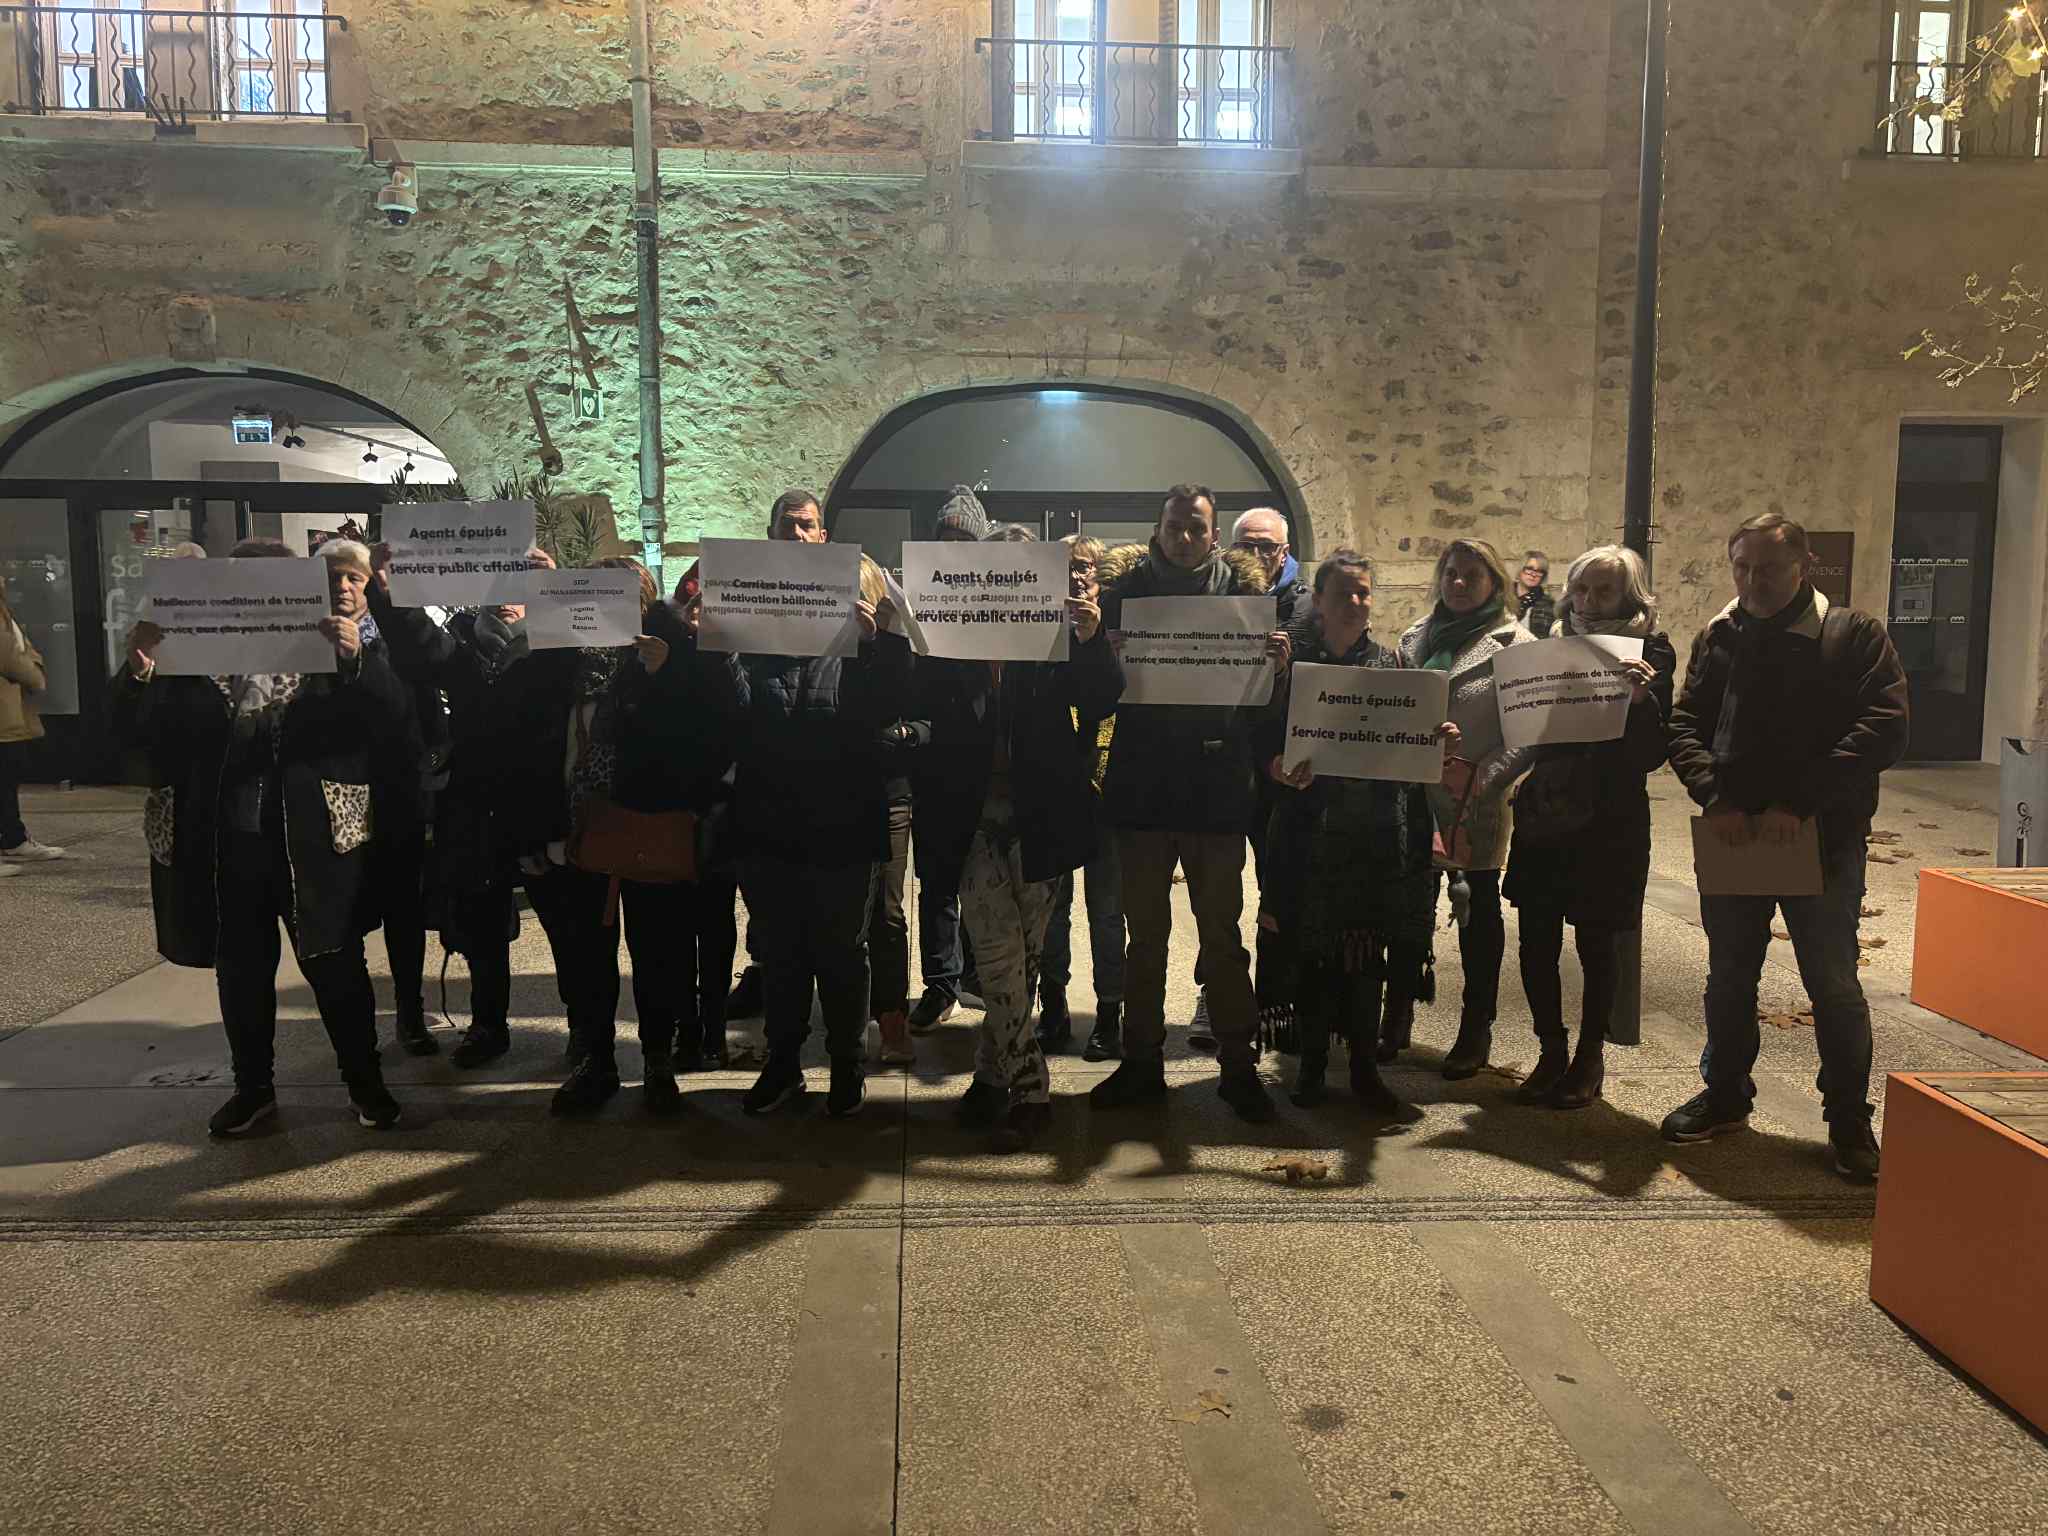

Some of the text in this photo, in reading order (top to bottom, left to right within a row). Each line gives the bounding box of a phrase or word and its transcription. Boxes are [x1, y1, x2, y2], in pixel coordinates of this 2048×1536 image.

[390, 562, 435, 574] Service
[438, 561, 480, 576] public
[932, 569, 1038, 586] Agents épuisés
[721, 592, 780, 604] Motivation
[916, 609, 958, 623] ervice
[961, 609, 1005, 625] public
[161, 624, 194, 635] ervice
[1125, 655, 1156, 666] Service
[1590, 669, 1602, 678] de
[1318, 690, 1417, 709] Agents épuisés
[1291, 725, 1335, 740] Service
[1338, 730, 1382, 745] public
